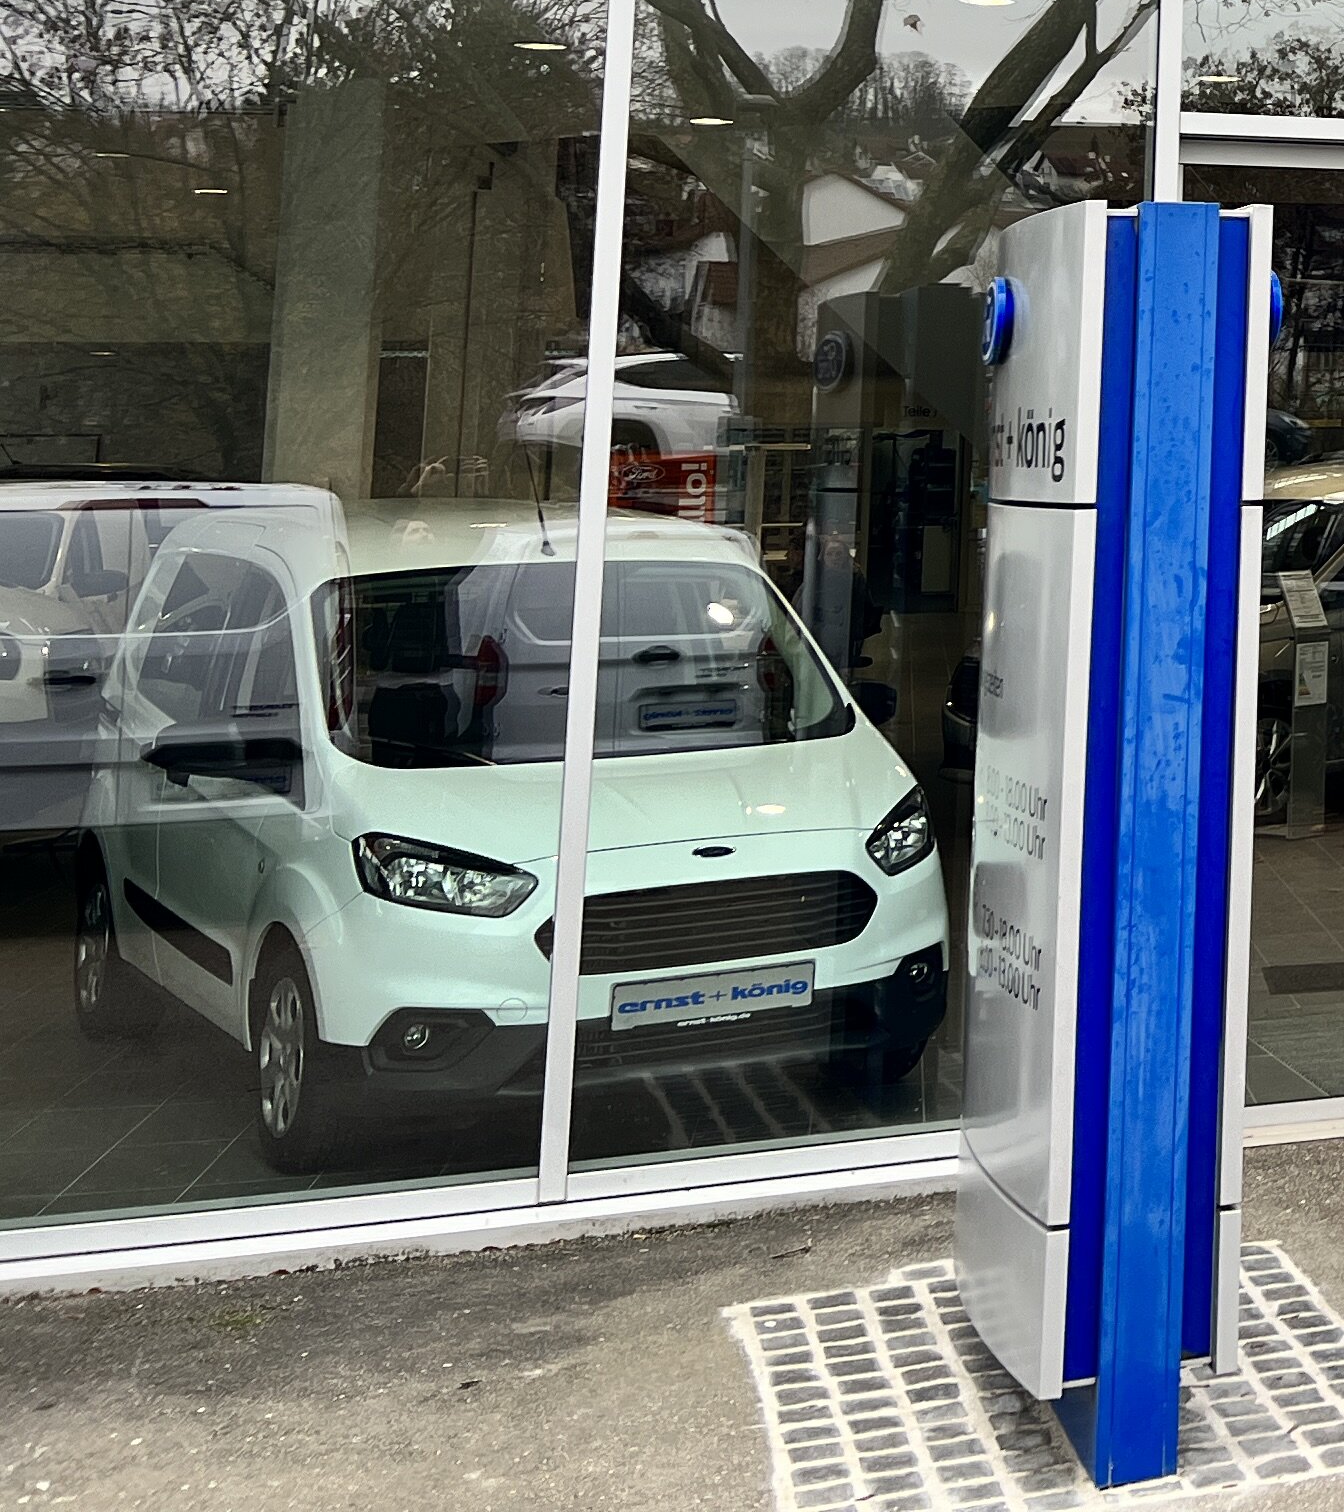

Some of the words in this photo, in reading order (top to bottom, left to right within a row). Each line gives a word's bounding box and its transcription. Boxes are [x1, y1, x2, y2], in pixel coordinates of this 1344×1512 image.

[1016, 406, 1066, 483] könig
[678, 462, 708, 520] llo!
[1028, 784, 1048, 822] Uhr
[1026, 823, 1046, 861] Uhr
[1022, 931, 1042, 972] Uhr
[617, 990, 706, 1014] ernst
[730, 978, 809, 1001] könig
[1021, 972, 1041, 1011] Uhr
